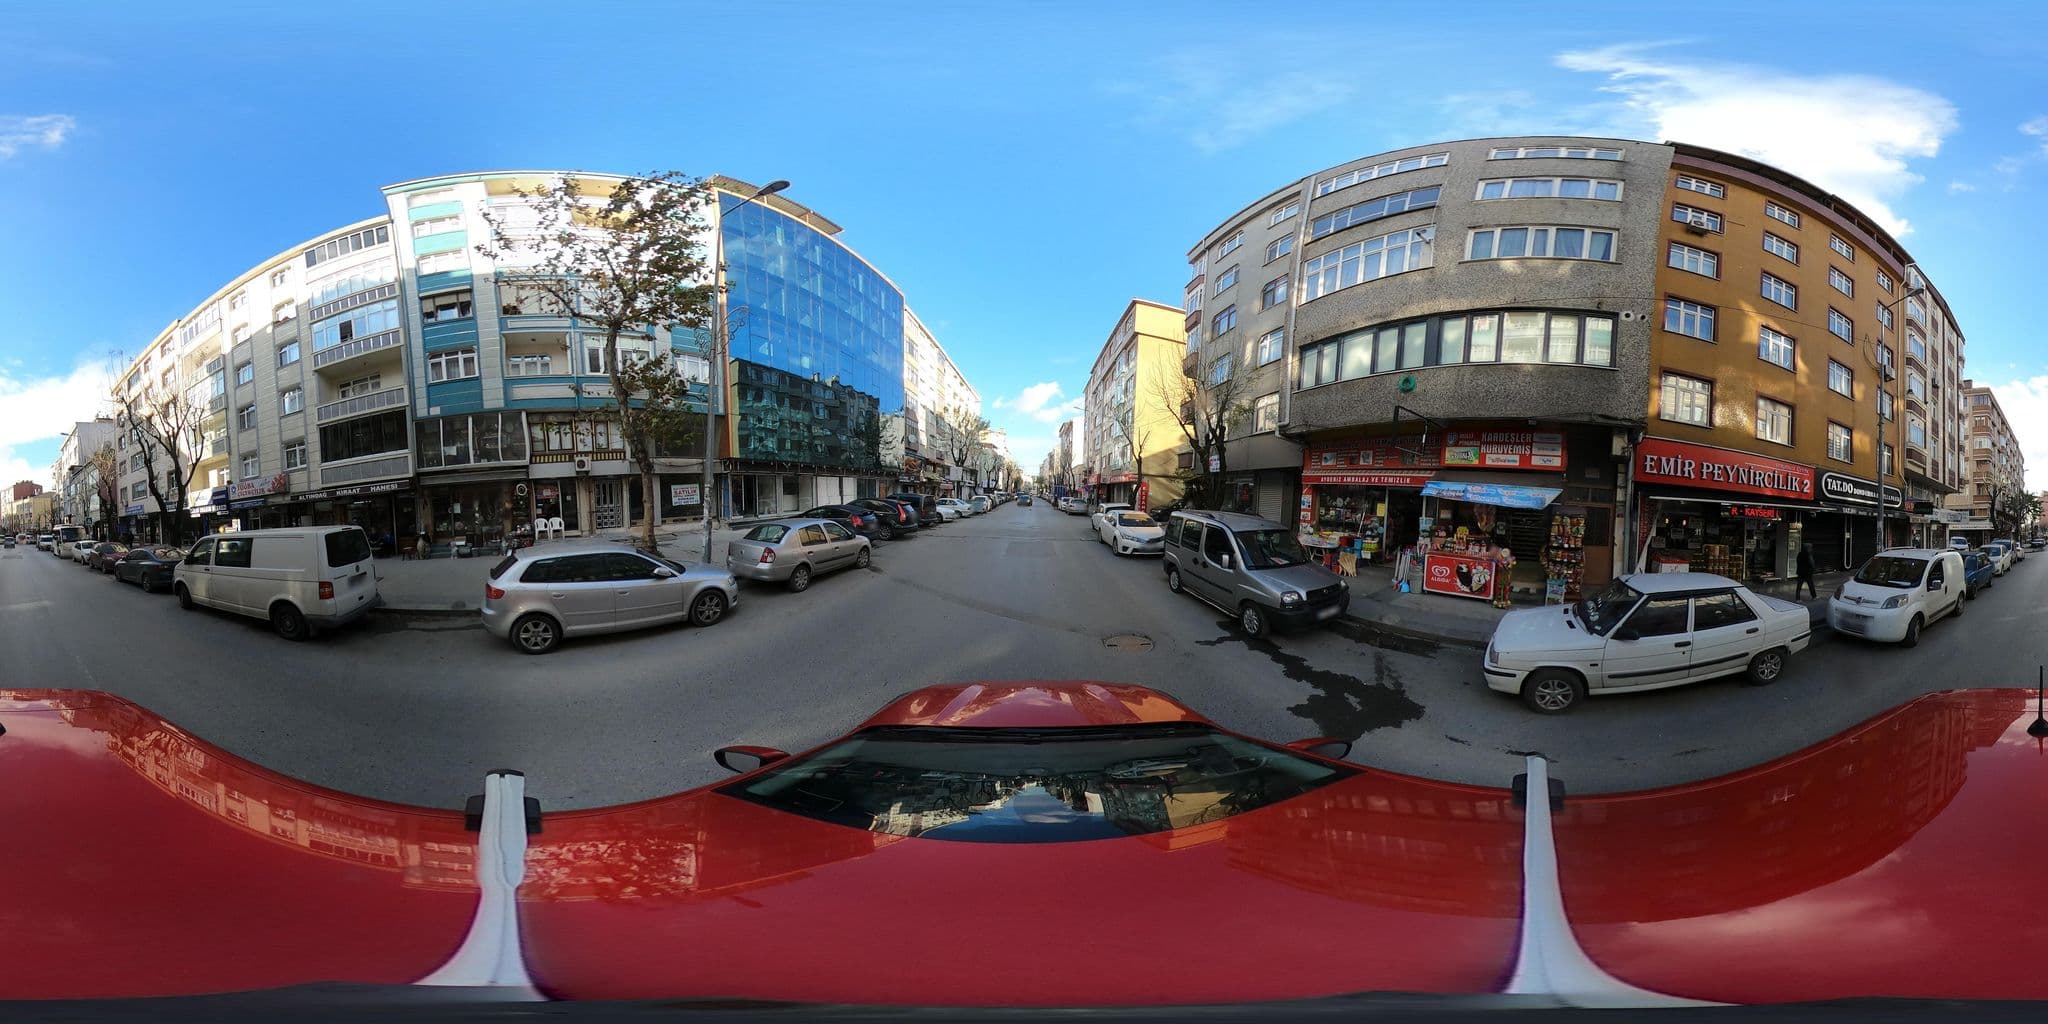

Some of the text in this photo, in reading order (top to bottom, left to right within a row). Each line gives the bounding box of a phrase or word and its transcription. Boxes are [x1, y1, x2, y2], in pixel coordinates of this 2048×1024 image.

[1645, 454, 1696, 480] EMİR
[1702, 461, 1800, 492] PEYNİRCİLİK
[1803, 479, 1811, 493] 2
